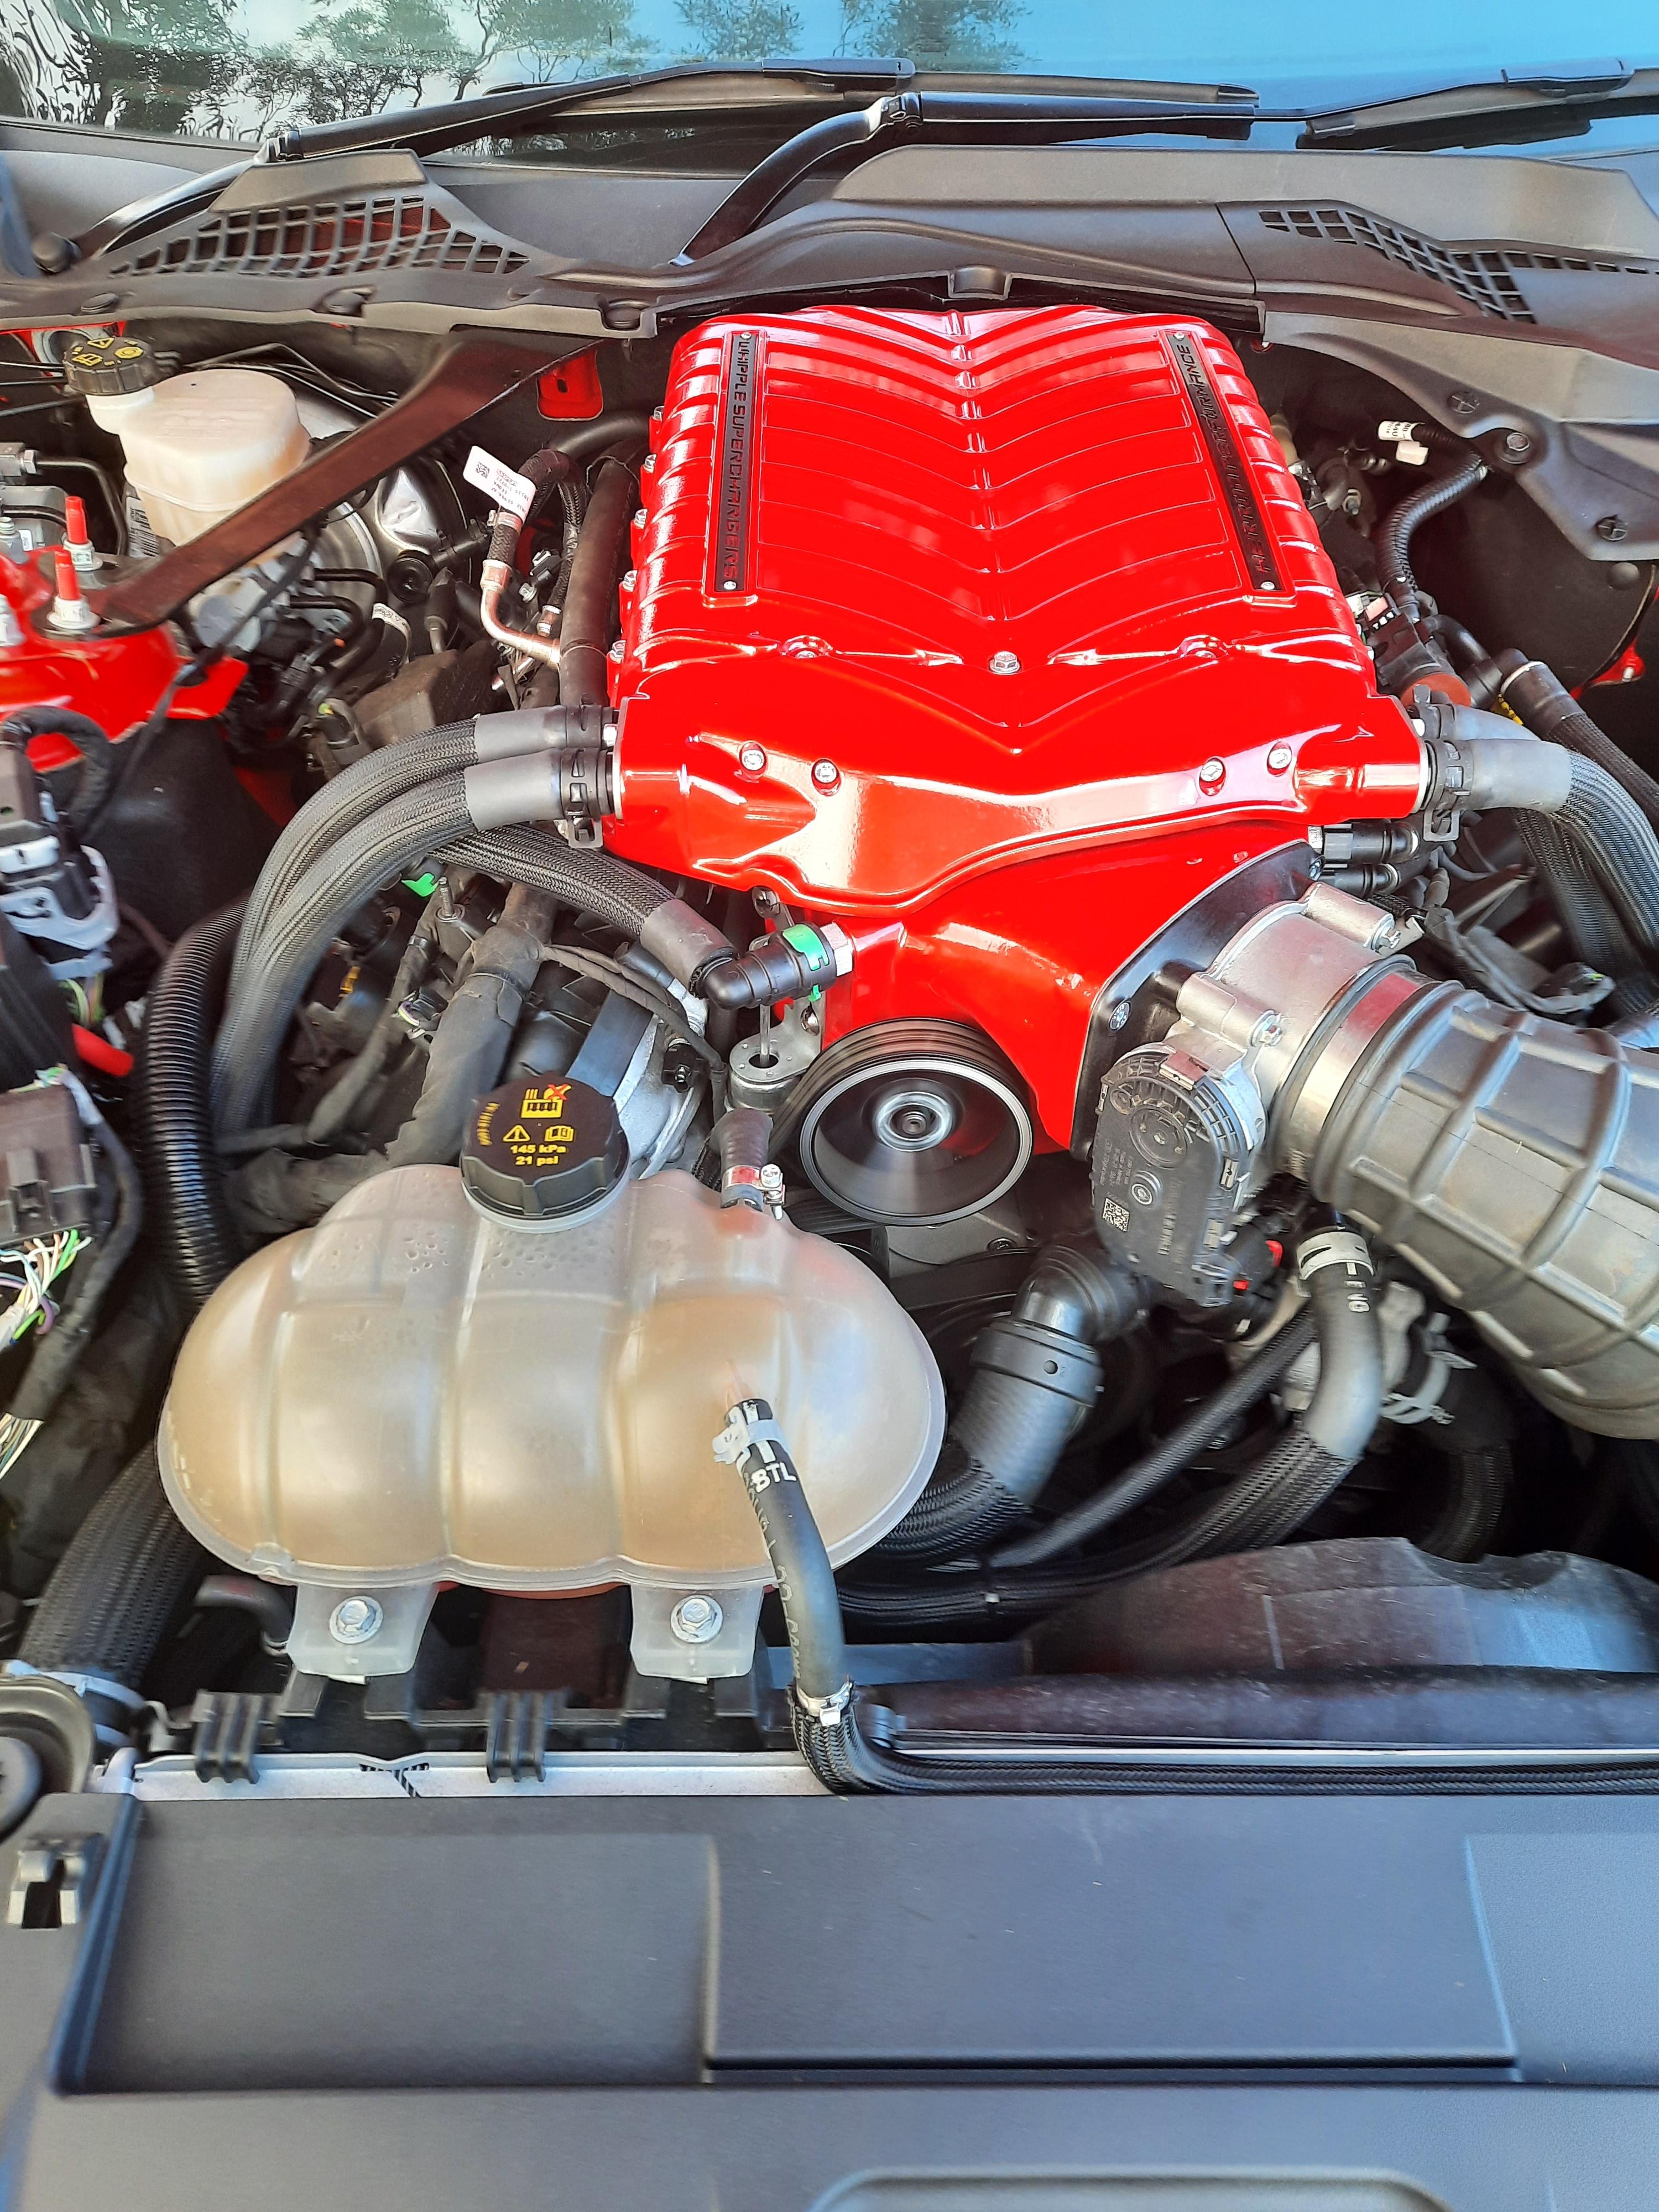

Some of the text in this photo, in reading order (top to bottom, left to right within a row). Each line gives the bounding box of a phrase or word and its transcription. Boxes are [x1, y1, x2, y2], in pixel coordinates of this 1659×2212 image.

[1176, 344, 1238, 471] PERFORMANCE
[723, 341, 751, 579] WHIPPLE SUPERCHARGERS
[510, 1144, 567, 1154] 145 kPa
[515, 1155, 559, 1167] 21 psi
